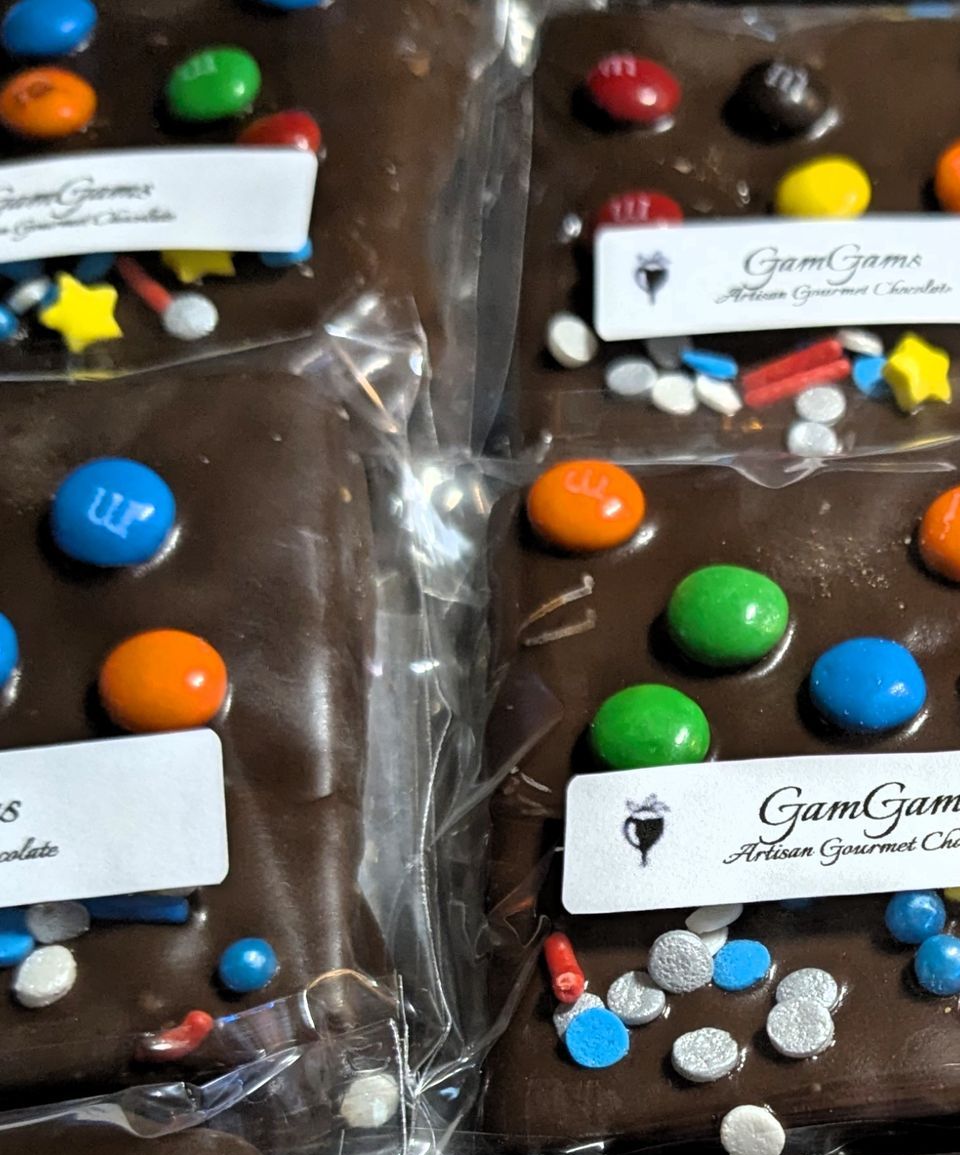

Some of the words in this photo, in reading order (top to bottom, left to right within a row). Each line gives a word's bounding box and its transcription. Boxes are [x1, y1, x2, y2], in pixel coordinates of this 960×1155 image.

[742, 243, 923, 292] GamGams
[713, 283, 788, 305] Artisan
[791, 284, 869, 307] Gourmet
[722, 841, 815, 865] Artisan
[819, 837, 918, 867] Gourmet
